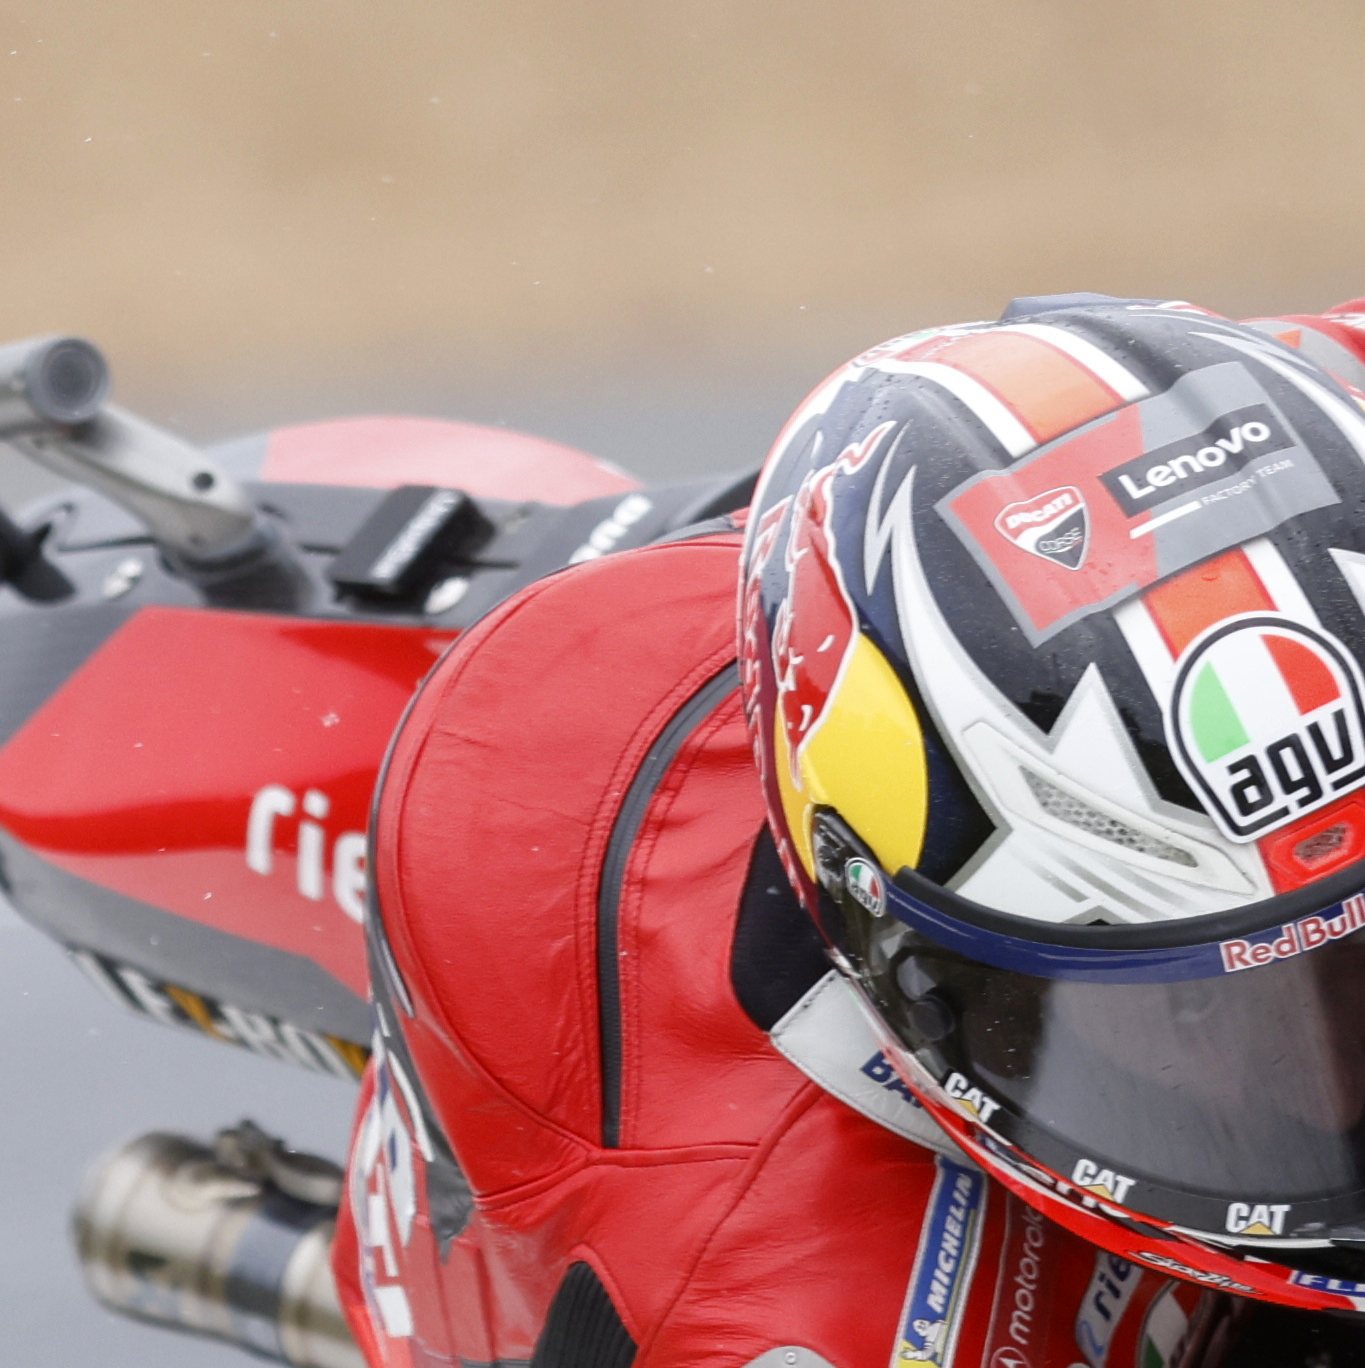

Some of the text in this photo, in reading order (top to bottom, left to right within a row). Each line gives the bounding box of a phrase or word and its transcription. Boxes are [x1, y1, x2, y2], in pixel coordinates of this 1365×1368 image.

[1117, 420, 1272, 500] Lenovo
[1201, 457, 1295, 507] FACTORY TEAM
[1004, 492, 1074, 530] DUCATI
[1038, 526, 1083, 554] CORSE
[1226, 706, 1355, 818] agv
[1220, 922, 1301, 973] Red
[943, 1071, 1001, 1124] CAT
[1072, 1158, 1136, 1205] CAT
[926, 1172, 973, 1315] MICHELIN
[1225, 1202, 1291, 1236] CAT
